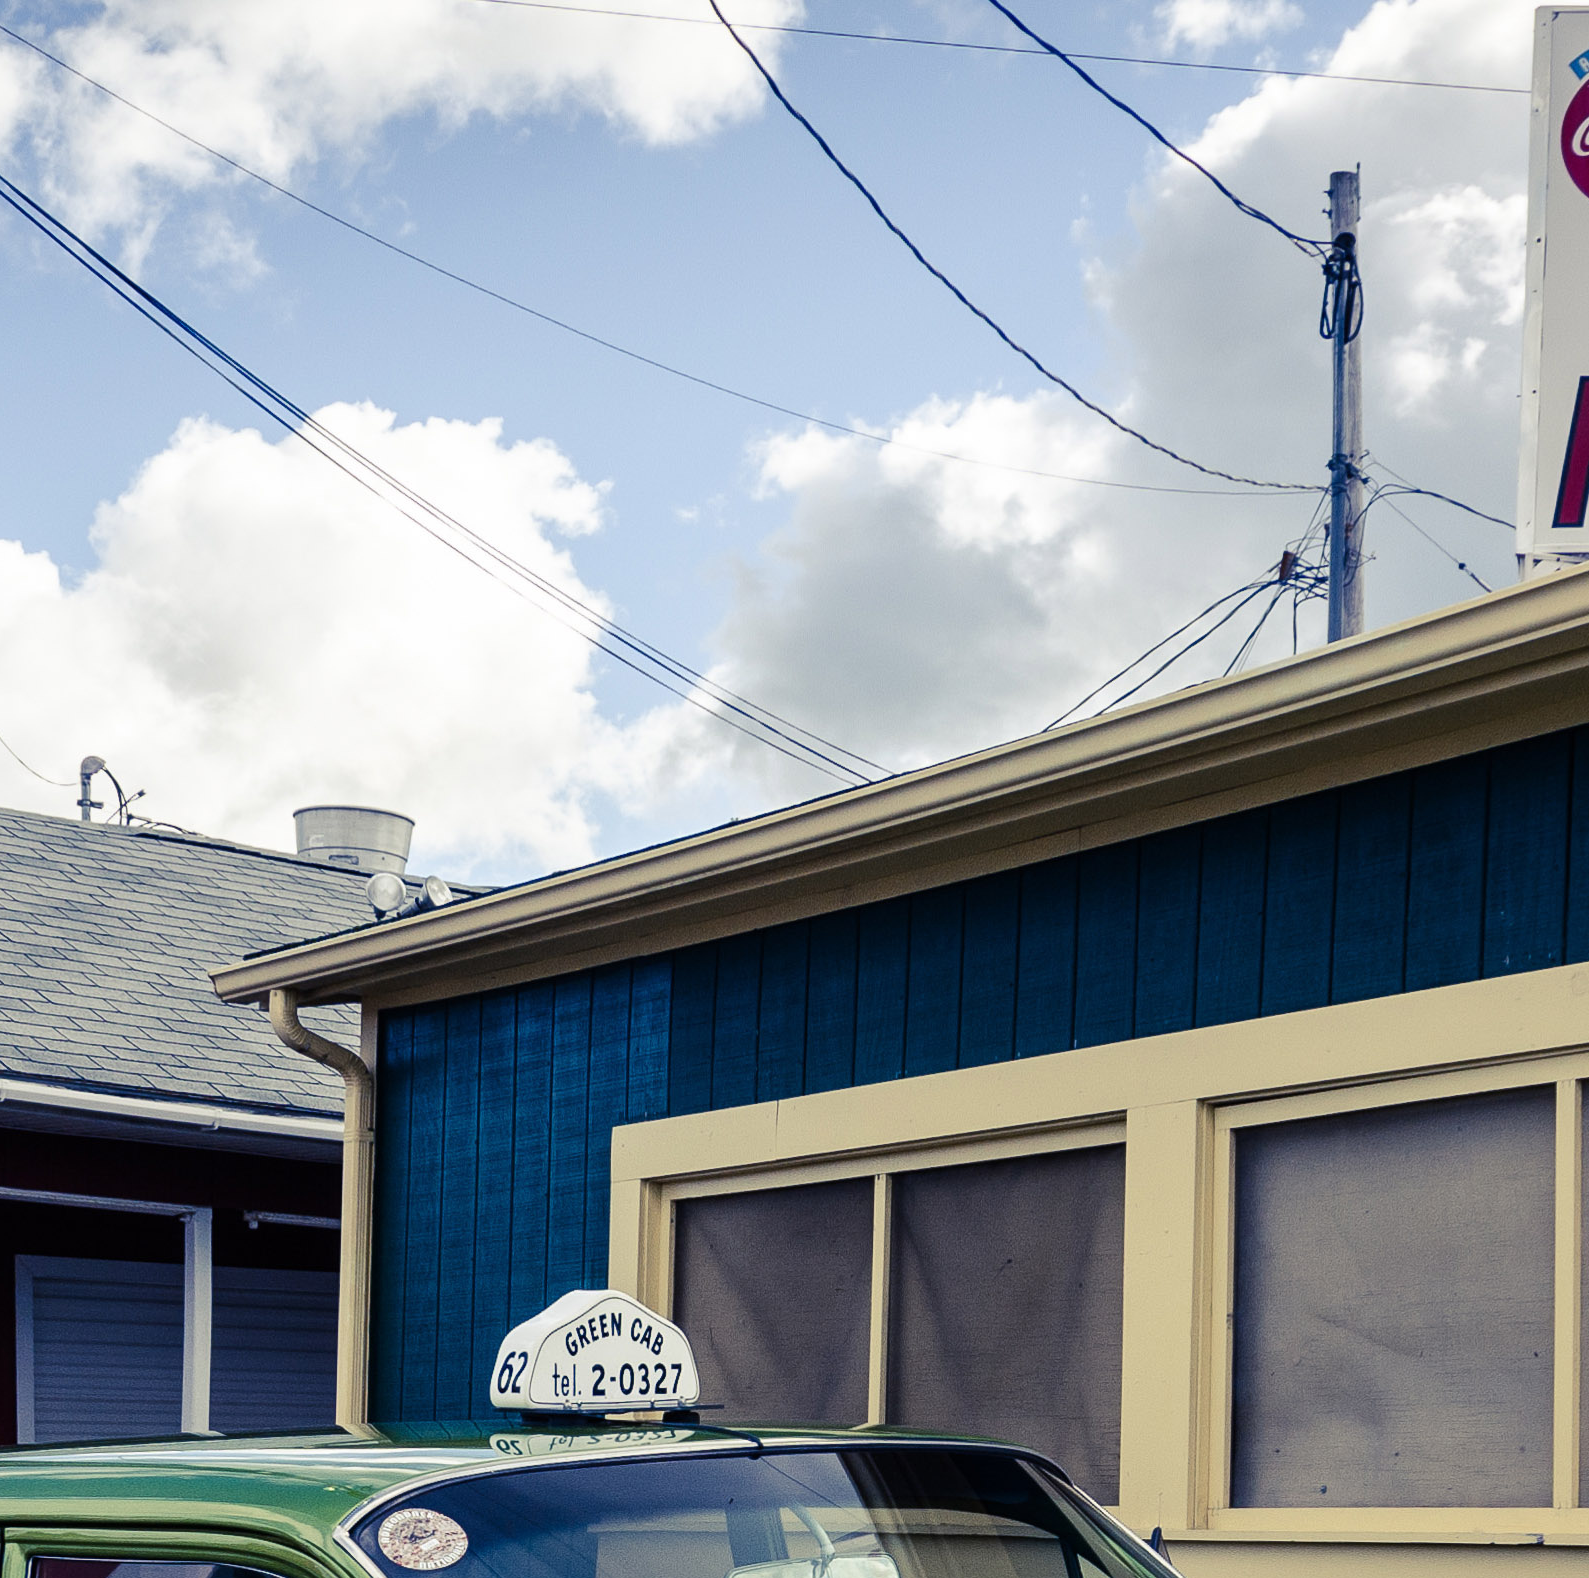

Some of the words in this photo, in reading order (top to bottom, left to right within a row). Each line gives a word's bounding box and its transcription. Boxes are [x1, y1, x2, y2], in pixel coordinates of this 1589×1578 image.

[565, 1312, 622, 1357] GREEN
[630, 1317, 664, 1356] CAB
[497, 1351, 529, 1394] 62
[551, 1362, 582, 1398] tel.
[591, 1362, 682, 1397] 2-0327
[380, 1510, 434, 1544] ADIRONDACK
